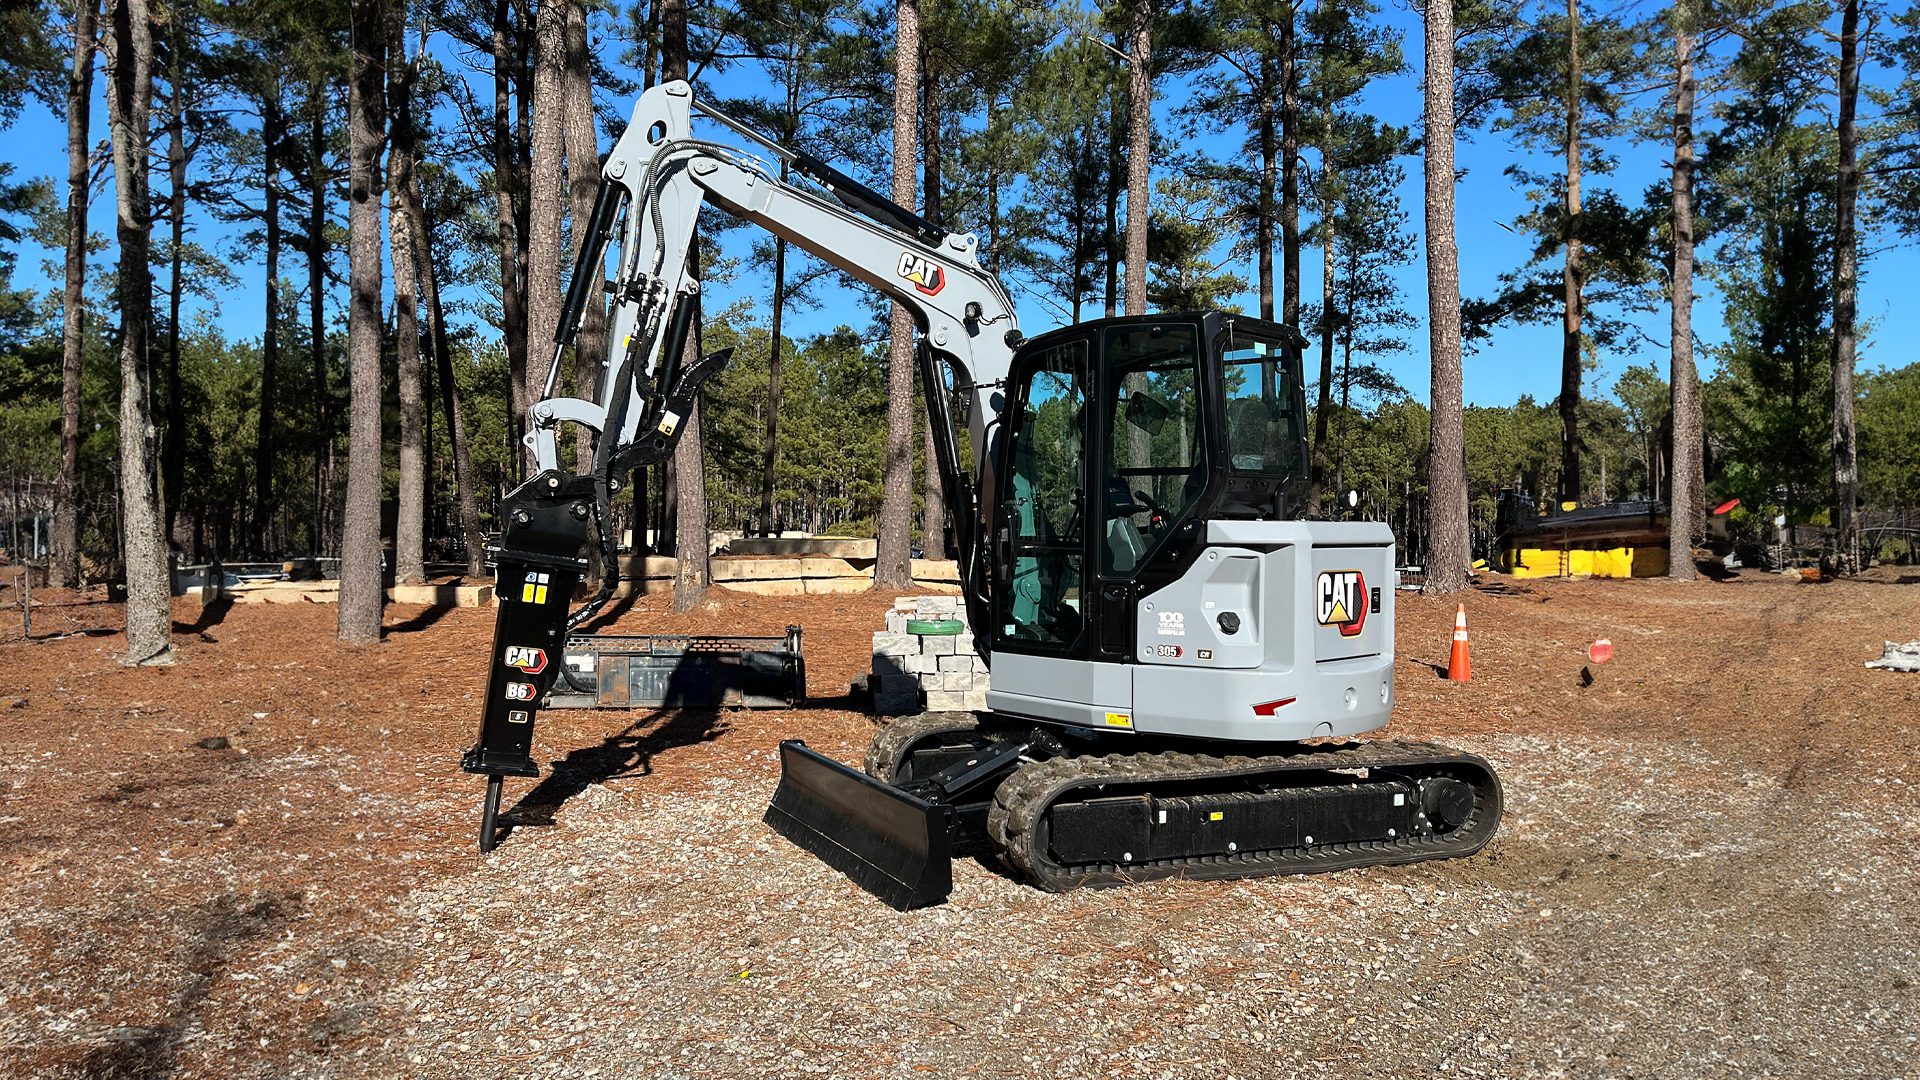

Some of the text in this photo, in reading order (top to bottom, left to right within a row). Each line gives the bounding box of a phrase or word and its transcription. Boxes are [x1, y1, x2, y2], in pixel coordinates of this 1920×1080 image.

[898, 252, 938, 287] CAT
[1318, 573, 1357, 624] CAT
[507, 647, 539, 667] CAT
[1158, 646, 1176, 657] 305
[508, 684, 527, 698] B6
